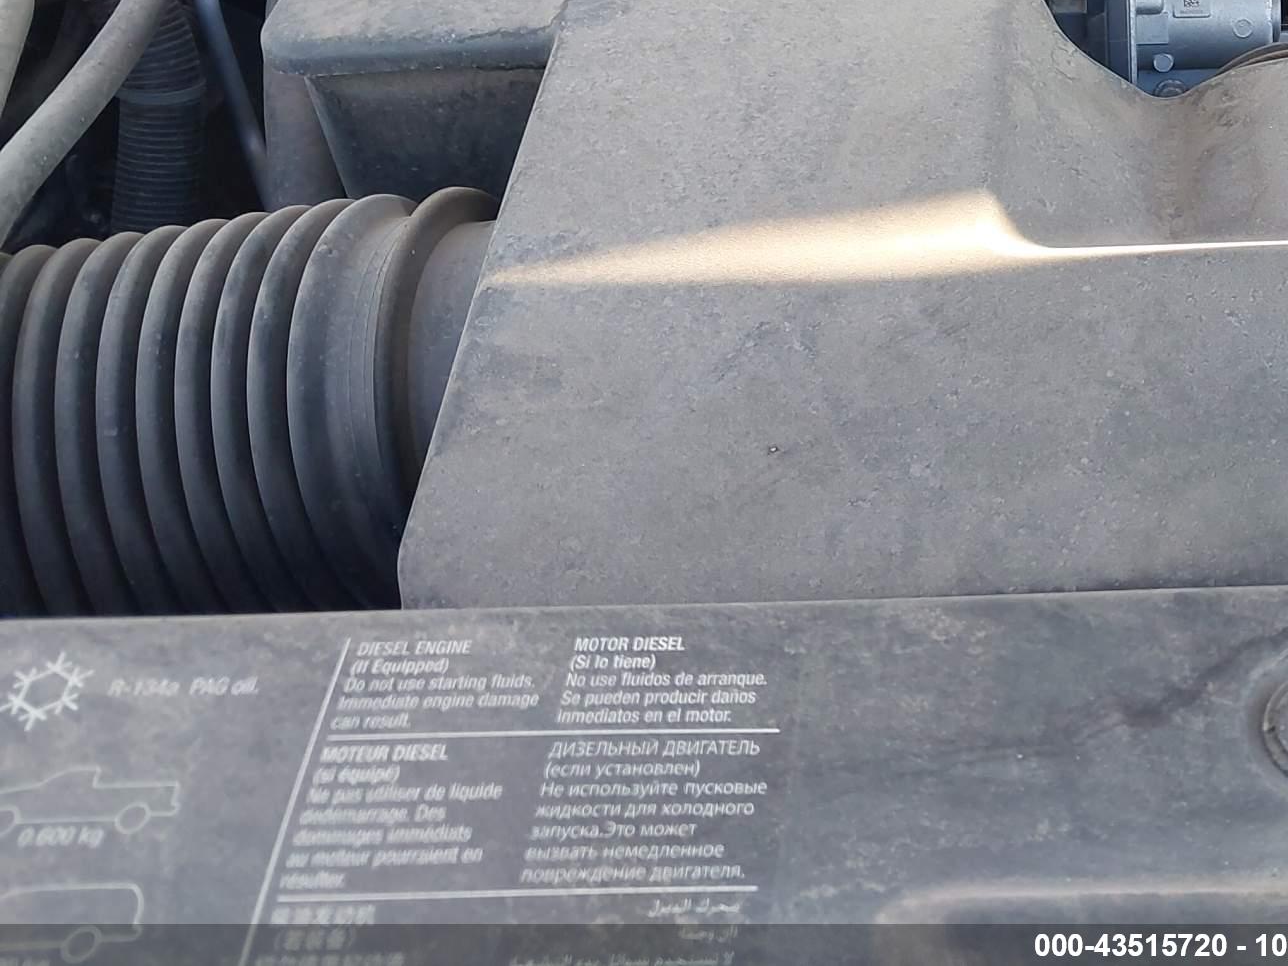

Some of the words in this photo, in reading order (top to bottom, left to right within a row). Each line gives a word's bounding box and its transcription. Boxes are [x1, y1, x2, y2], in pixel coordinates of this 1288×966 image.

[356, 641, 409, 656] DIESEL
[415, 640, 472, 655] ENGINE
[574, 637, 629, 651] MOTOR
[632, 636, 685, 651] DIESEL
[371, 658, 450, 675] Equipped)
[570, 654, 591, 671] (Si
[594, 654, 609, 668] lo
[613, 654, 657, 670] tiene)
[344, 678, 365, 693] Do
[367, 677, 393, 692] not
[397, 679, 424, 692] use
[428, 675, 487, 691] starting
[490, 674, 535, 689] fluids.
[566, 673, 586, 687] No
[590, 675, 617, 686] use
[621, 672, 671, 686] fluidos
[674, 672, 694, 685] de
[697, 673, 768, 689] arranque.
[337, 694, 419, 711] Immediate
[422, 695, 474, 712] engine
[478, 692, 540, 710] damage
[560, 690, 581, 705] Se
[584, 690, 640, 707] pueden
[644, 689, 708, 706] producir
[711, 688, 757, 704] daños
[331, 715, 360, 730] can
[363, 713, 411, 729] result.
[644, 710, 663, 722] en
[667, 709, 682, 722] el
[685, 708, 732, 722] motor.
[320, 745, 390, 763] MOTEUR
[391, 744, 449, 762] DIESEL
[548, 741, 659, 759] ДИЗЕЛЬНЫЙ
[662, 740, 761, 757] ДВИГАТЕЛЬ
[544, 762, 591, 779] (если
[595, 761, 701, 779] установлен)
[424, 783, 446, 802] de
[449, 782, 503, 803] liquide
[540, 782, 564, 797] Не
[568, 781, 678, 799] используйте
[683, 782, 768, 799] пусковые
[535, 803, 621, 819] жидкости
[624, 803, 657, 818] для
[661, 801, 755, 817] холодного
[640, 822, 698, 837] может
[525, 845, 597, 862] вызвать
[602, 842, 725, 861] немедленное
[649, 864, 746, 883] двигателя.
